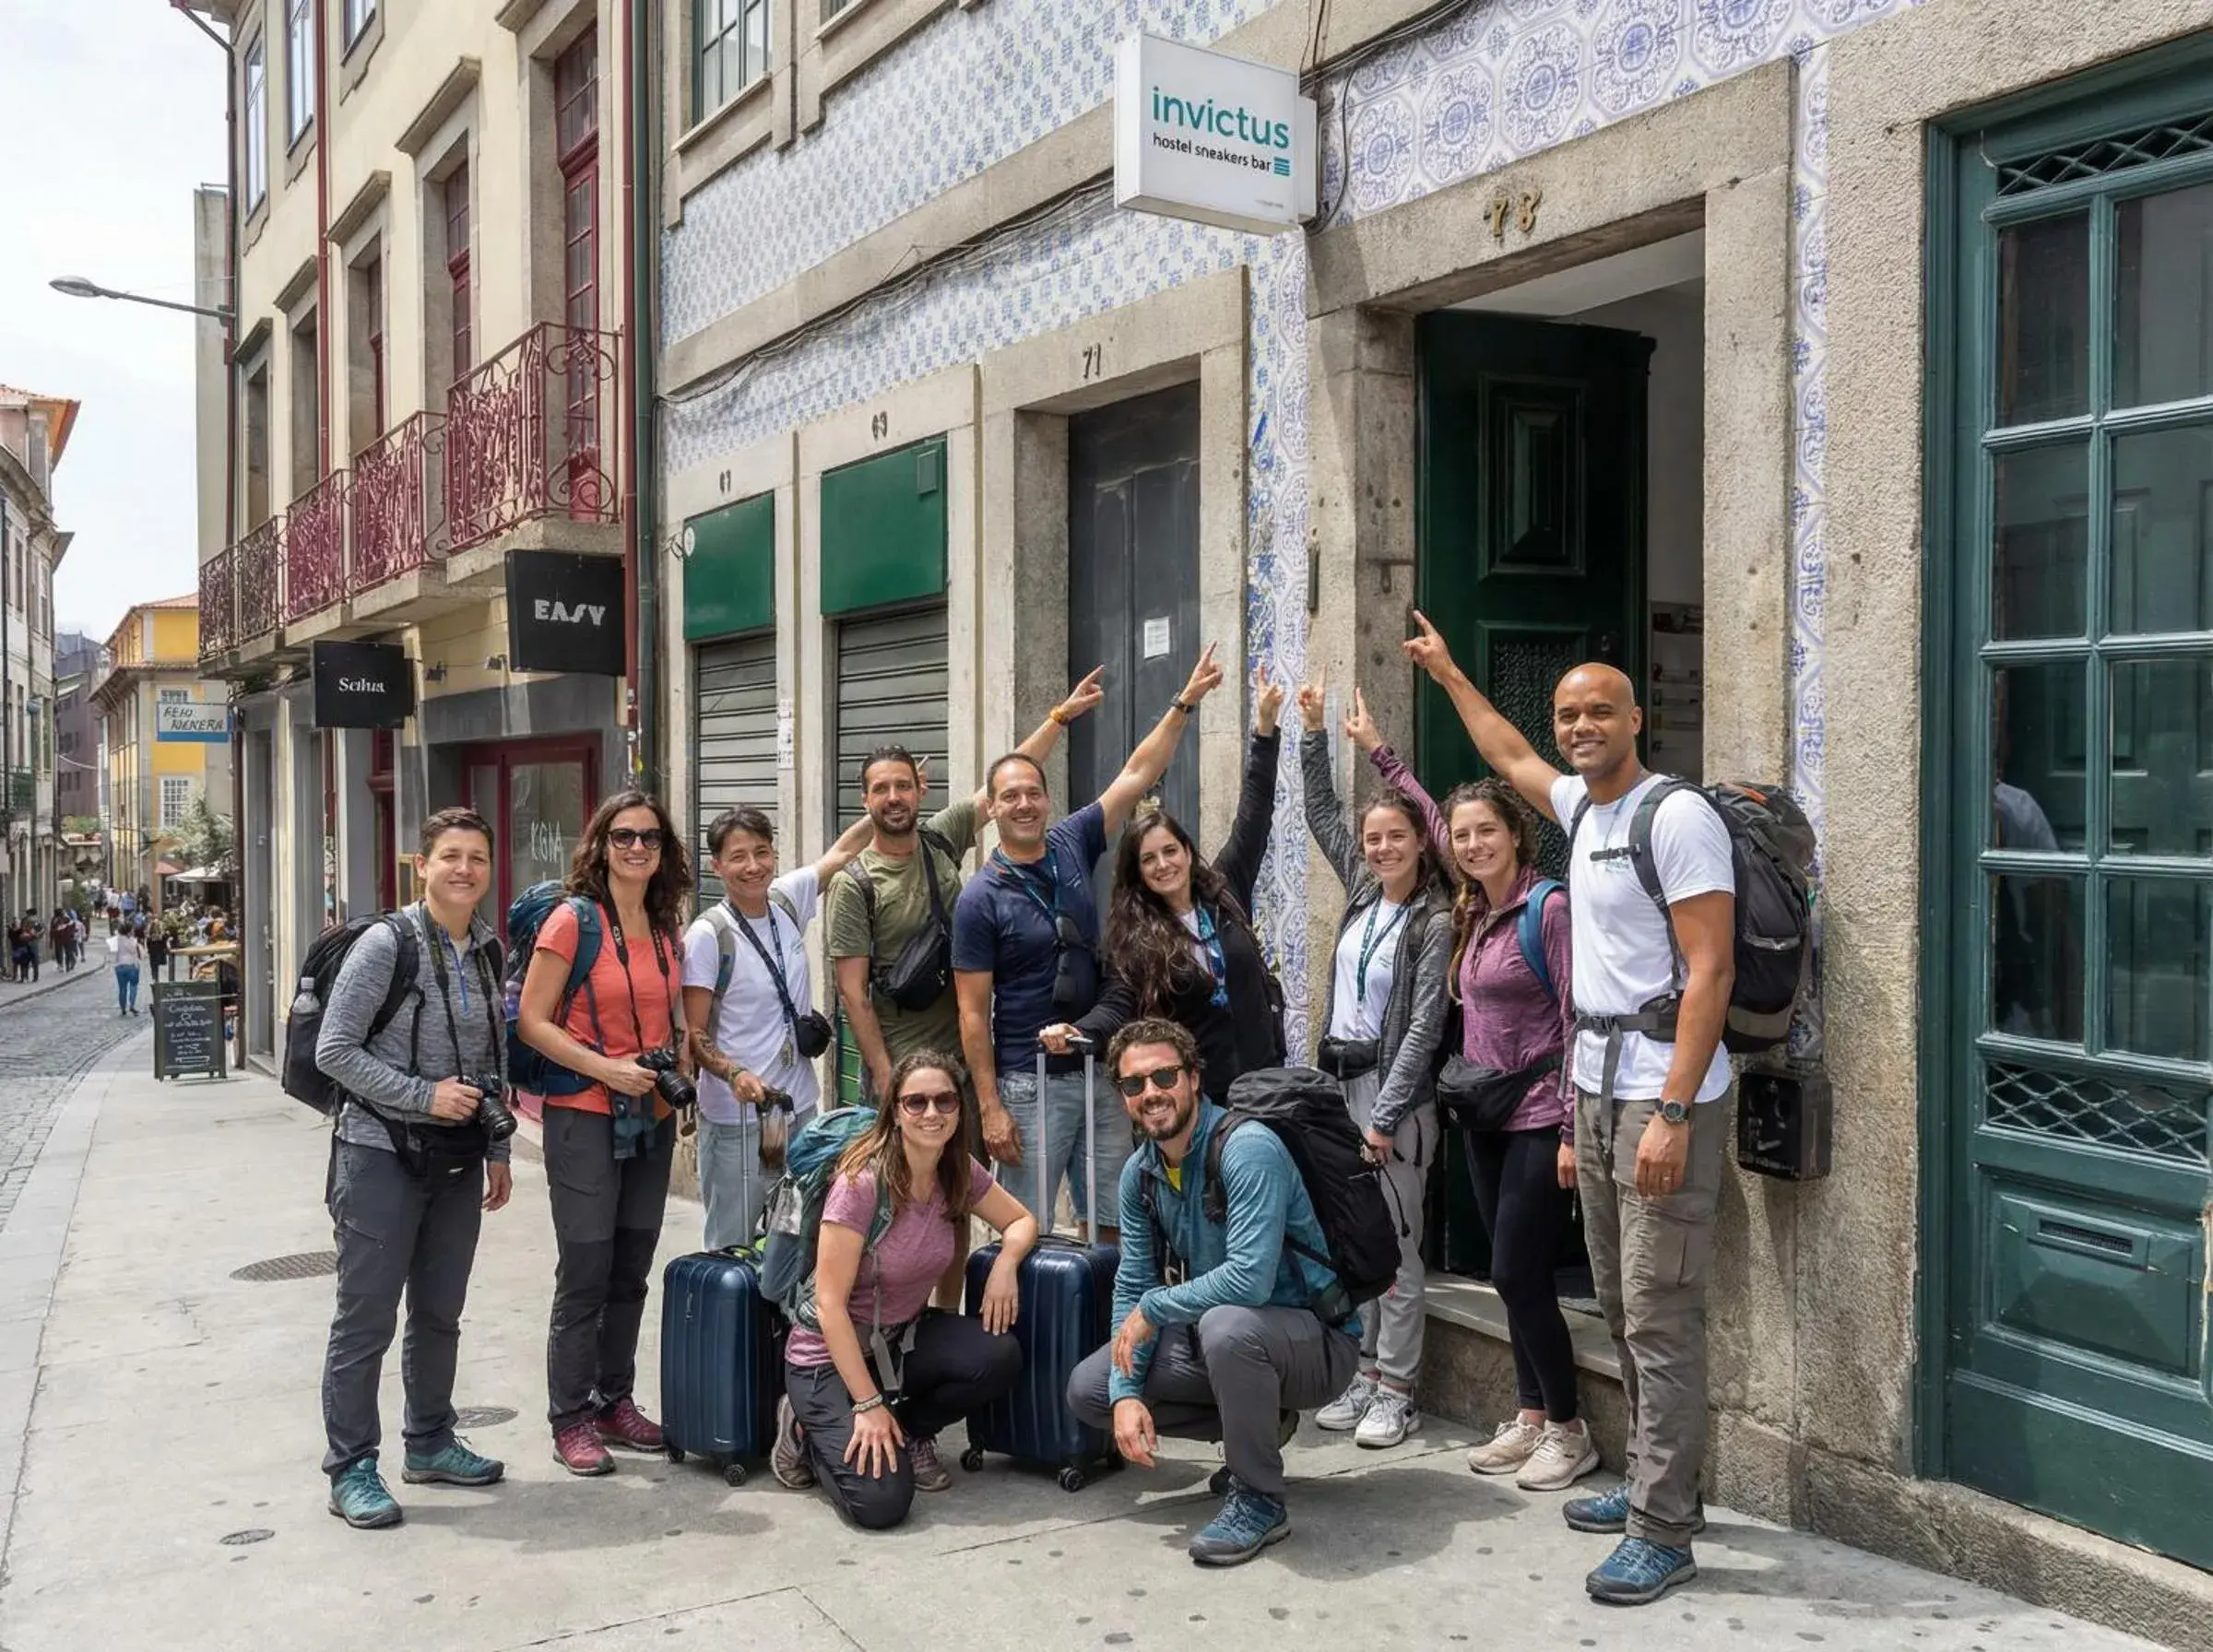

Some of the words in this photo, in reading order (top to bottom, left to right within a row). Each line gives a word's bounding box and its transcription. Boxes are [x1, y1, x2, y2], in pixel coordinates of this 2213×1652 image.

[1153, 86, 1290, 148] invictus
[1153, 132, 1192, 154] hostel
[1194, 144, 1249, 167] sneakers
[1251, 154, 1272, 172] bar
[1484, 189, 1543, 237] 78
[1083, 342, 1101, 379] 71
[535, 599, 606, 626] EASY
